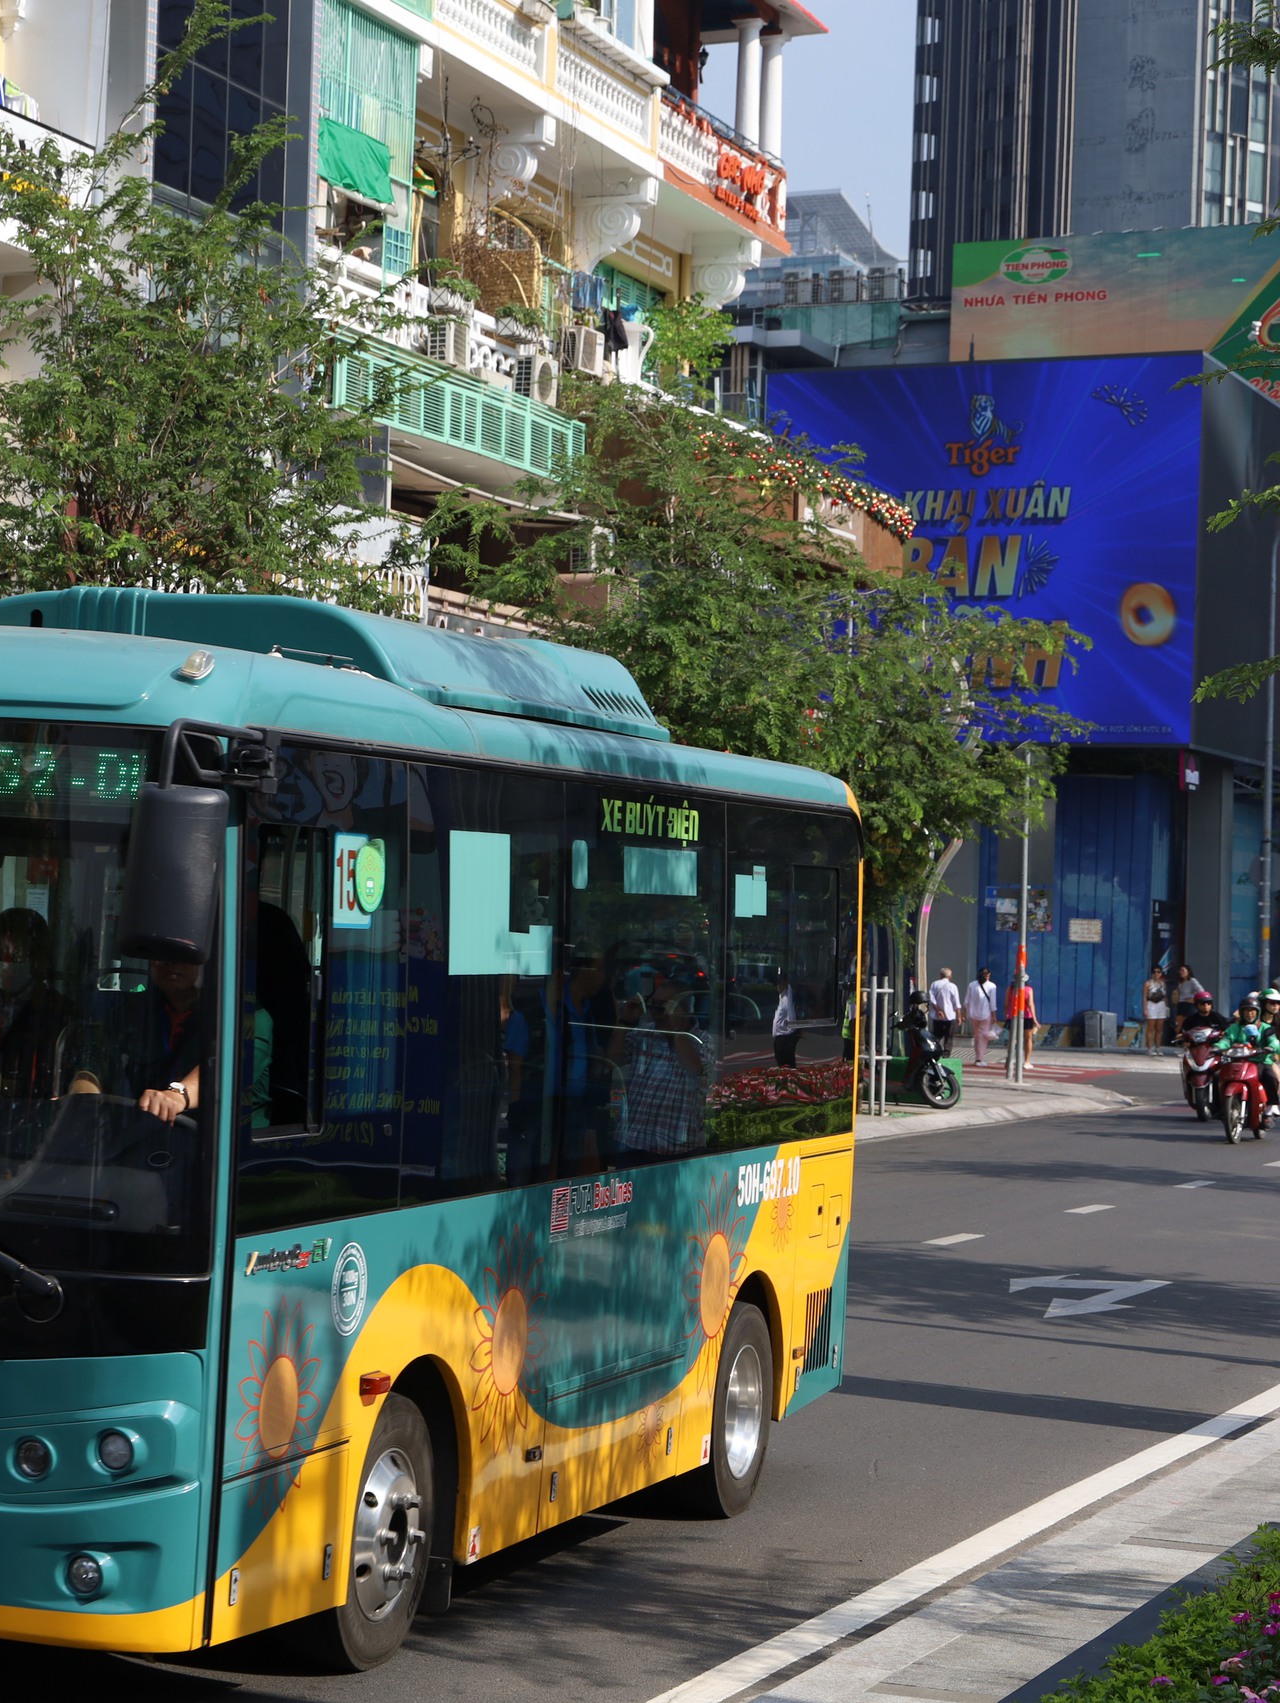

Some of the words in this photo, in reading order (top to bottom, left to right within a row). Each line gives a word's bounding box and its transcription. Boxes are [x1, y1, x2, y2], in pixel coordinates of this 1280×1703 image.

[1031, 260, 1067, 270] PHONG
[964, 294, 1005, 310] NHỰA
[1055, 290, 1107, 303] PHONG
[945, 439, 1021, 476] Tiger
[905, 489, 976, 521] KHAI
[985, 480, 1071, 519] XUÂN
[31, 751, 55, 796] 2
[601, 798, 622, 833] XE
[625, 795, 665, 837] BUÝT
[666, 800, 699, 847] ĐIỆN
[336, 848, 358, 911] 15
[569, 1183, 592, 1215] FUTA
[593, 1182, 610, 1210] Bus
[610, 1178, 633, 1207] Lines
[737, 1156, 800, 1208] 50H-697.10
